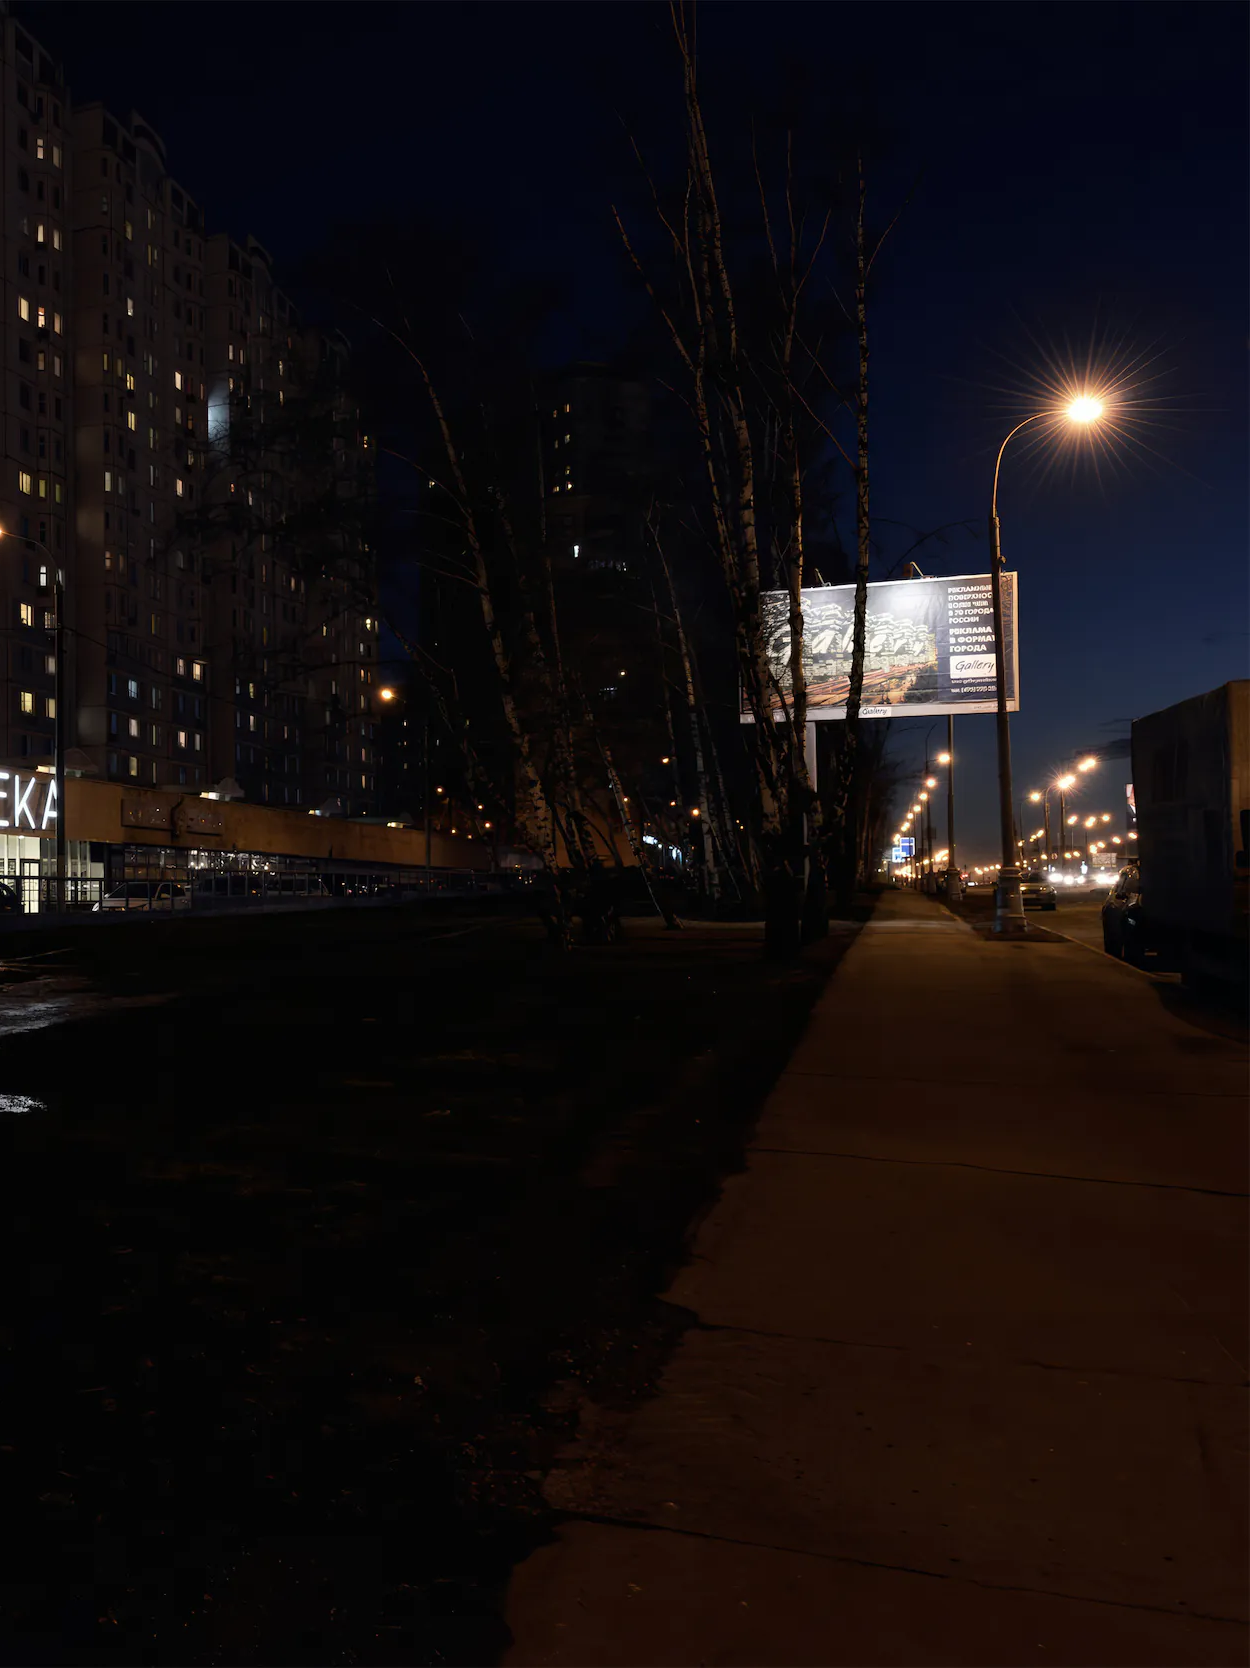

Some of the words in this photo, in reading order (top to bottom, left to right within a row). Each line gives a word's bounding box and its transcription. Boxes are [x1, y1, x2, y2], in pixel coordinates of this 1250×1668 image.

[949, 616, 979, 624] РОССИИ
[949, 626, 992, 635] РЕКЛАМА
[950, 644, 987, 652] ГОРОДА
[955, 660, 995, 673] Gallery
